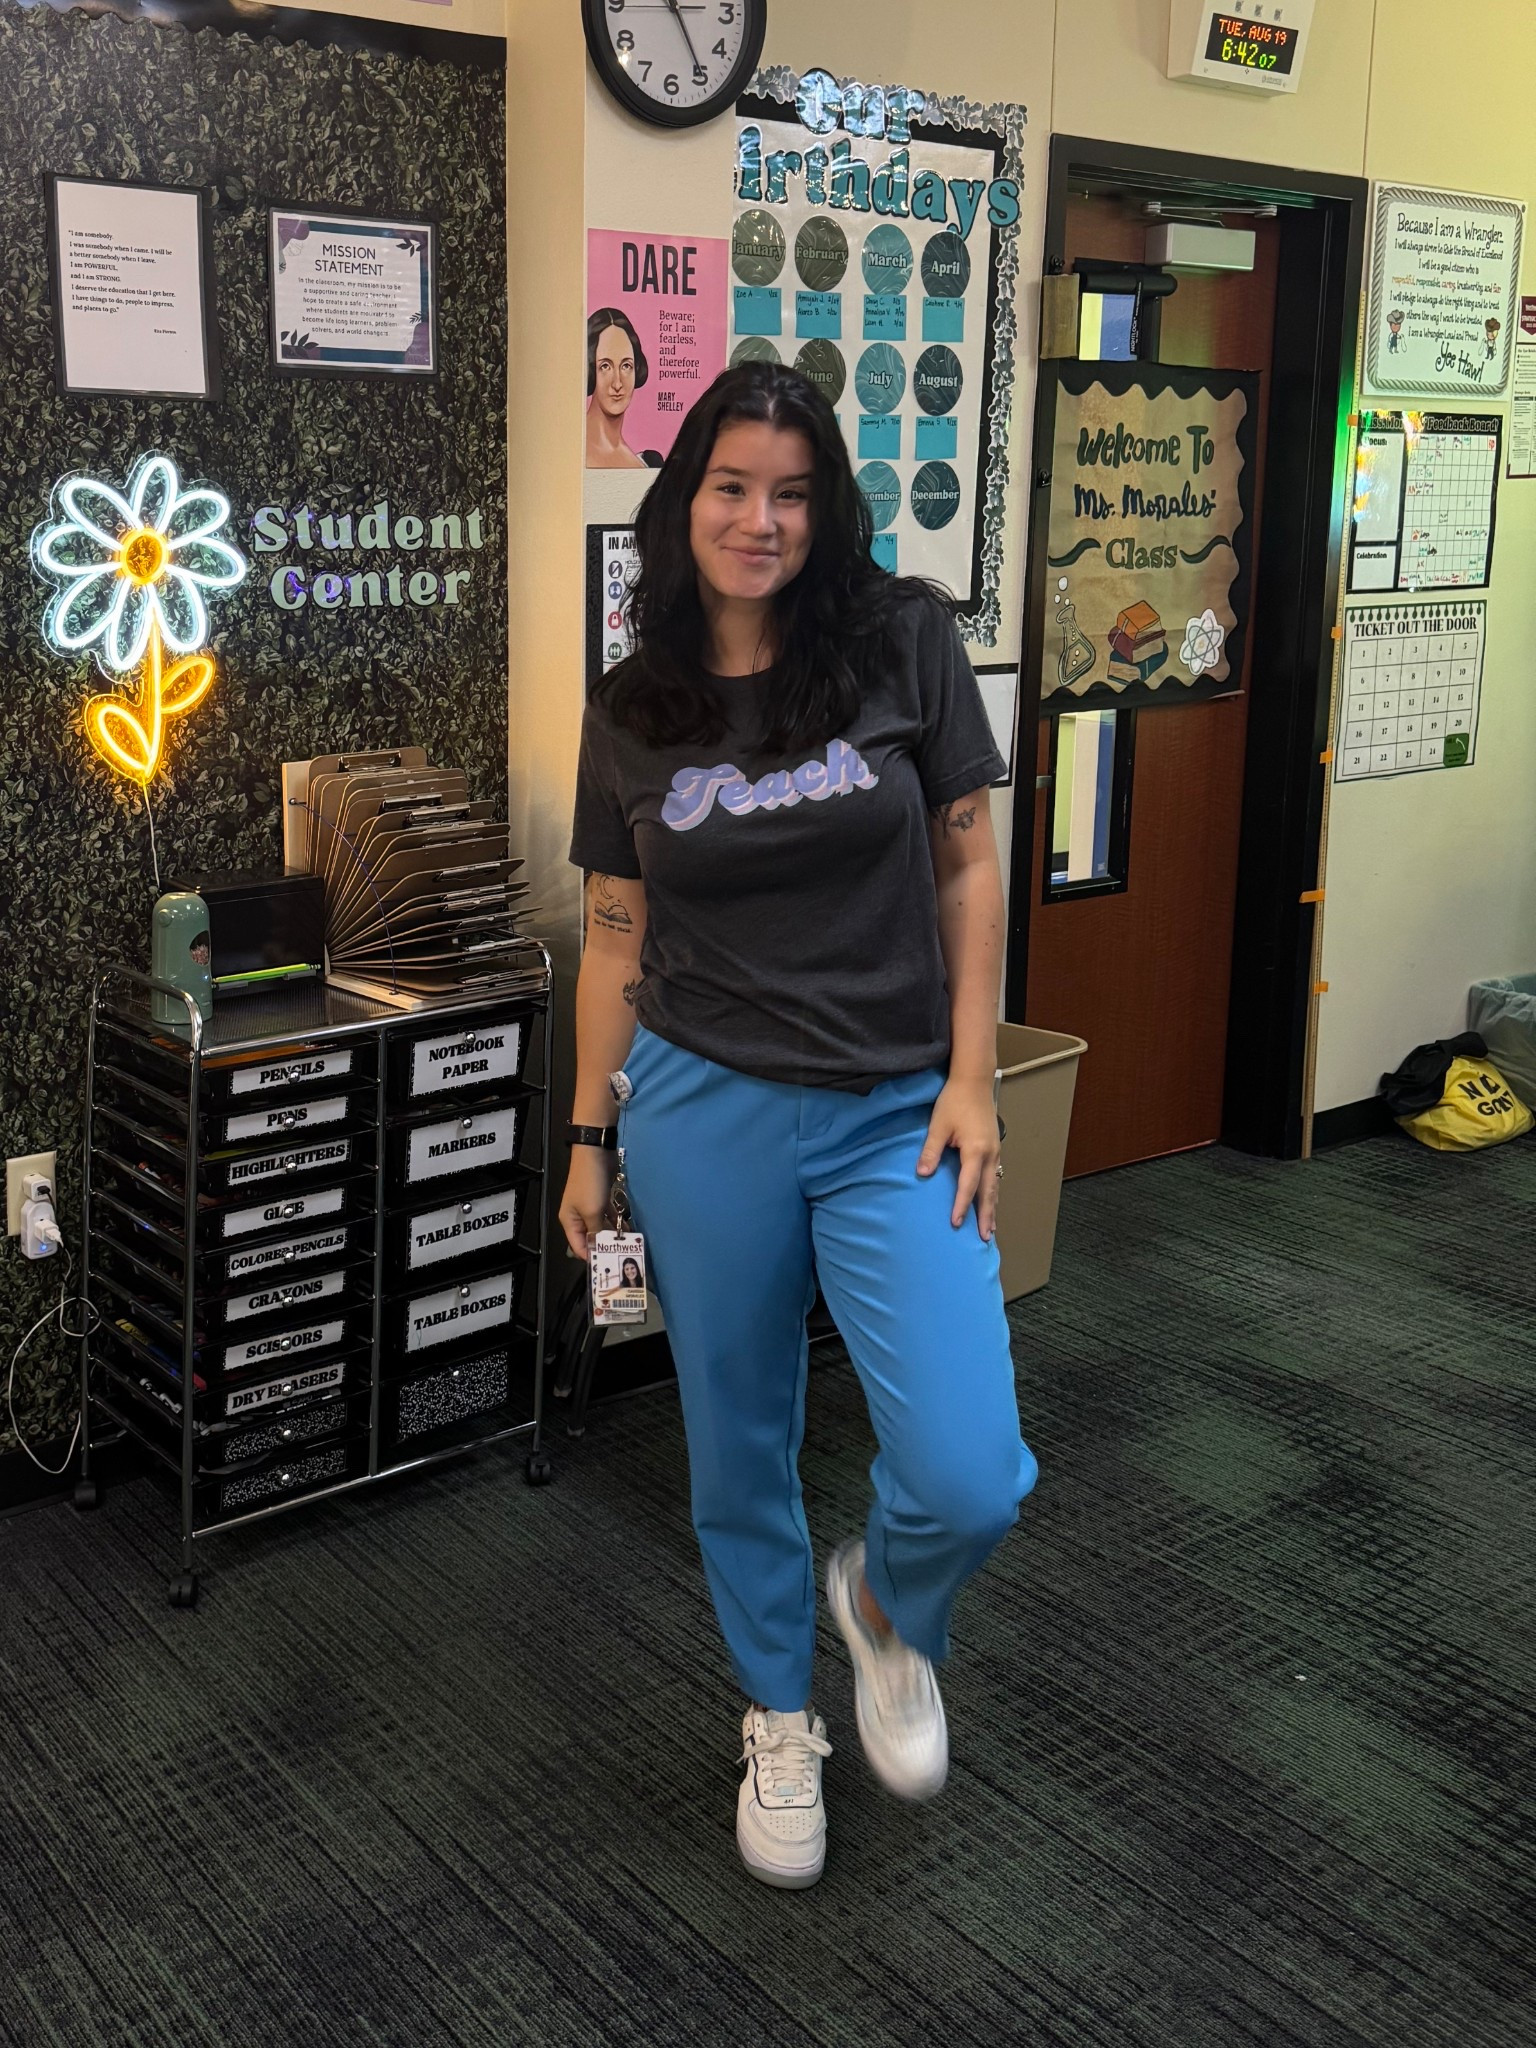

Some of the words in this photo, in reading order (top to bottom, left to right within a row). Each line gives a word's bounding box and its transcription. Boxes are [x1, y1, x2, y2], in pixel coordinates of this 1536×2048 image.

[717, 2, 734, 25] 3
[617, 30, 635, 51] 8
[1219, 18, 1246, 38] TUE,
[1248, 25, 1272, 42] AUG
[1275, 30, 1287, 45] 19
[712, 38, 727, 59] 4
[1222, 38, 1259, 66] 6:42
[1259, 54, 1277, 69] 07
[638, 60, 652, 82] 7
[692, 65, 708, 86] 5
[663, 74, 679, 96] 6
[737, 124, 1020, 242] irthdays
[1397, 212, 1433, 235] Because
[1434, 216, 1439, 236] I
[1440, 224, 1454, 237] am
[1455, 226, 1461, 238] a
[323, 243, 376, 260] MISSION
[796, 246, 849, 264] February
[868, 252, 908, 269] March
[931, 260, 961, 277] April
[315, 259, 384, 277] STATEMENT
[622, 241, 698, 296] DARE
[659, 310, 695, 323] Beware;
[659, 321, 672, 332] for
[681, 325, 696, 333] am
[659, 333, 697, 347] fearless,
[659, 345, 676, 355] and
[659, 356, 700, 367] therefore
[659, 368, 701, 381] powerful.
[868, 370, 893, 389] July
[918, 373, 959, 388] August
[657, 391, 676, 401] MARY
[657, 401, 684, 412] SHELLEY
[1076, 422, 1181, 469] Welcome
[1186, 425, 1215, 475] To
[864, 490, 900, 501] vember
[911, 489, 960, 501] December
[1074, 483, 1116, 520] Ms.
[253, 499, 485, 552] Student
[608, 536, 619, 550] IN
[1105, 537, 1178, 571] Class
[1356, 551, 1388, 559] Celebration
[270, 563, 472, 610] Center
[1354, 621, 1395, 637] TICKET
[1397, 620, 1420, 635] OUT
[1422, 618, 1444, 632] THE
[1446, 617, 1477, 631] DOOR
[1362, 650, 1366, 658] 1
[1413, 646, 1418, 654] 3
[1463, 642, 1468, 650] 5
[1386, 674, 1390, 682] 7
[1411, 672, 1416, 680] 8
[1459, 668, 1466, 676] 10
[1383, 701, 1390, 709] 12
[1433, 696, 1440, 704] 14
[1454, 719, 1462, 727] 20
[1354, 757, 1360, 765] 21
[661, 738, 879, 832] Teach
[428, 1036, 505, 1062] NOTEBOOK
[442, 1059, 489, 1079] PAPER
[428, 1132, 496, 1158] MARKERS
[263, 1201, 304, 1221] GLE
[416, 1223, 462, 1247] TABLE
[463, 1210, 509, 1234] BOXES
[291, 1234, 344, 1254] PENCILS
[597, 1242, 643, 1253] Northwest
[248, 1280, 323, 1309] CRAYONS
[414, 1307, 459, 1330] TABLE
[461, 1294, 506, 1317] BOXES
[246, 1329, 323, 1359] SCISORS
[232, 1388, 266, 1409] DRY
